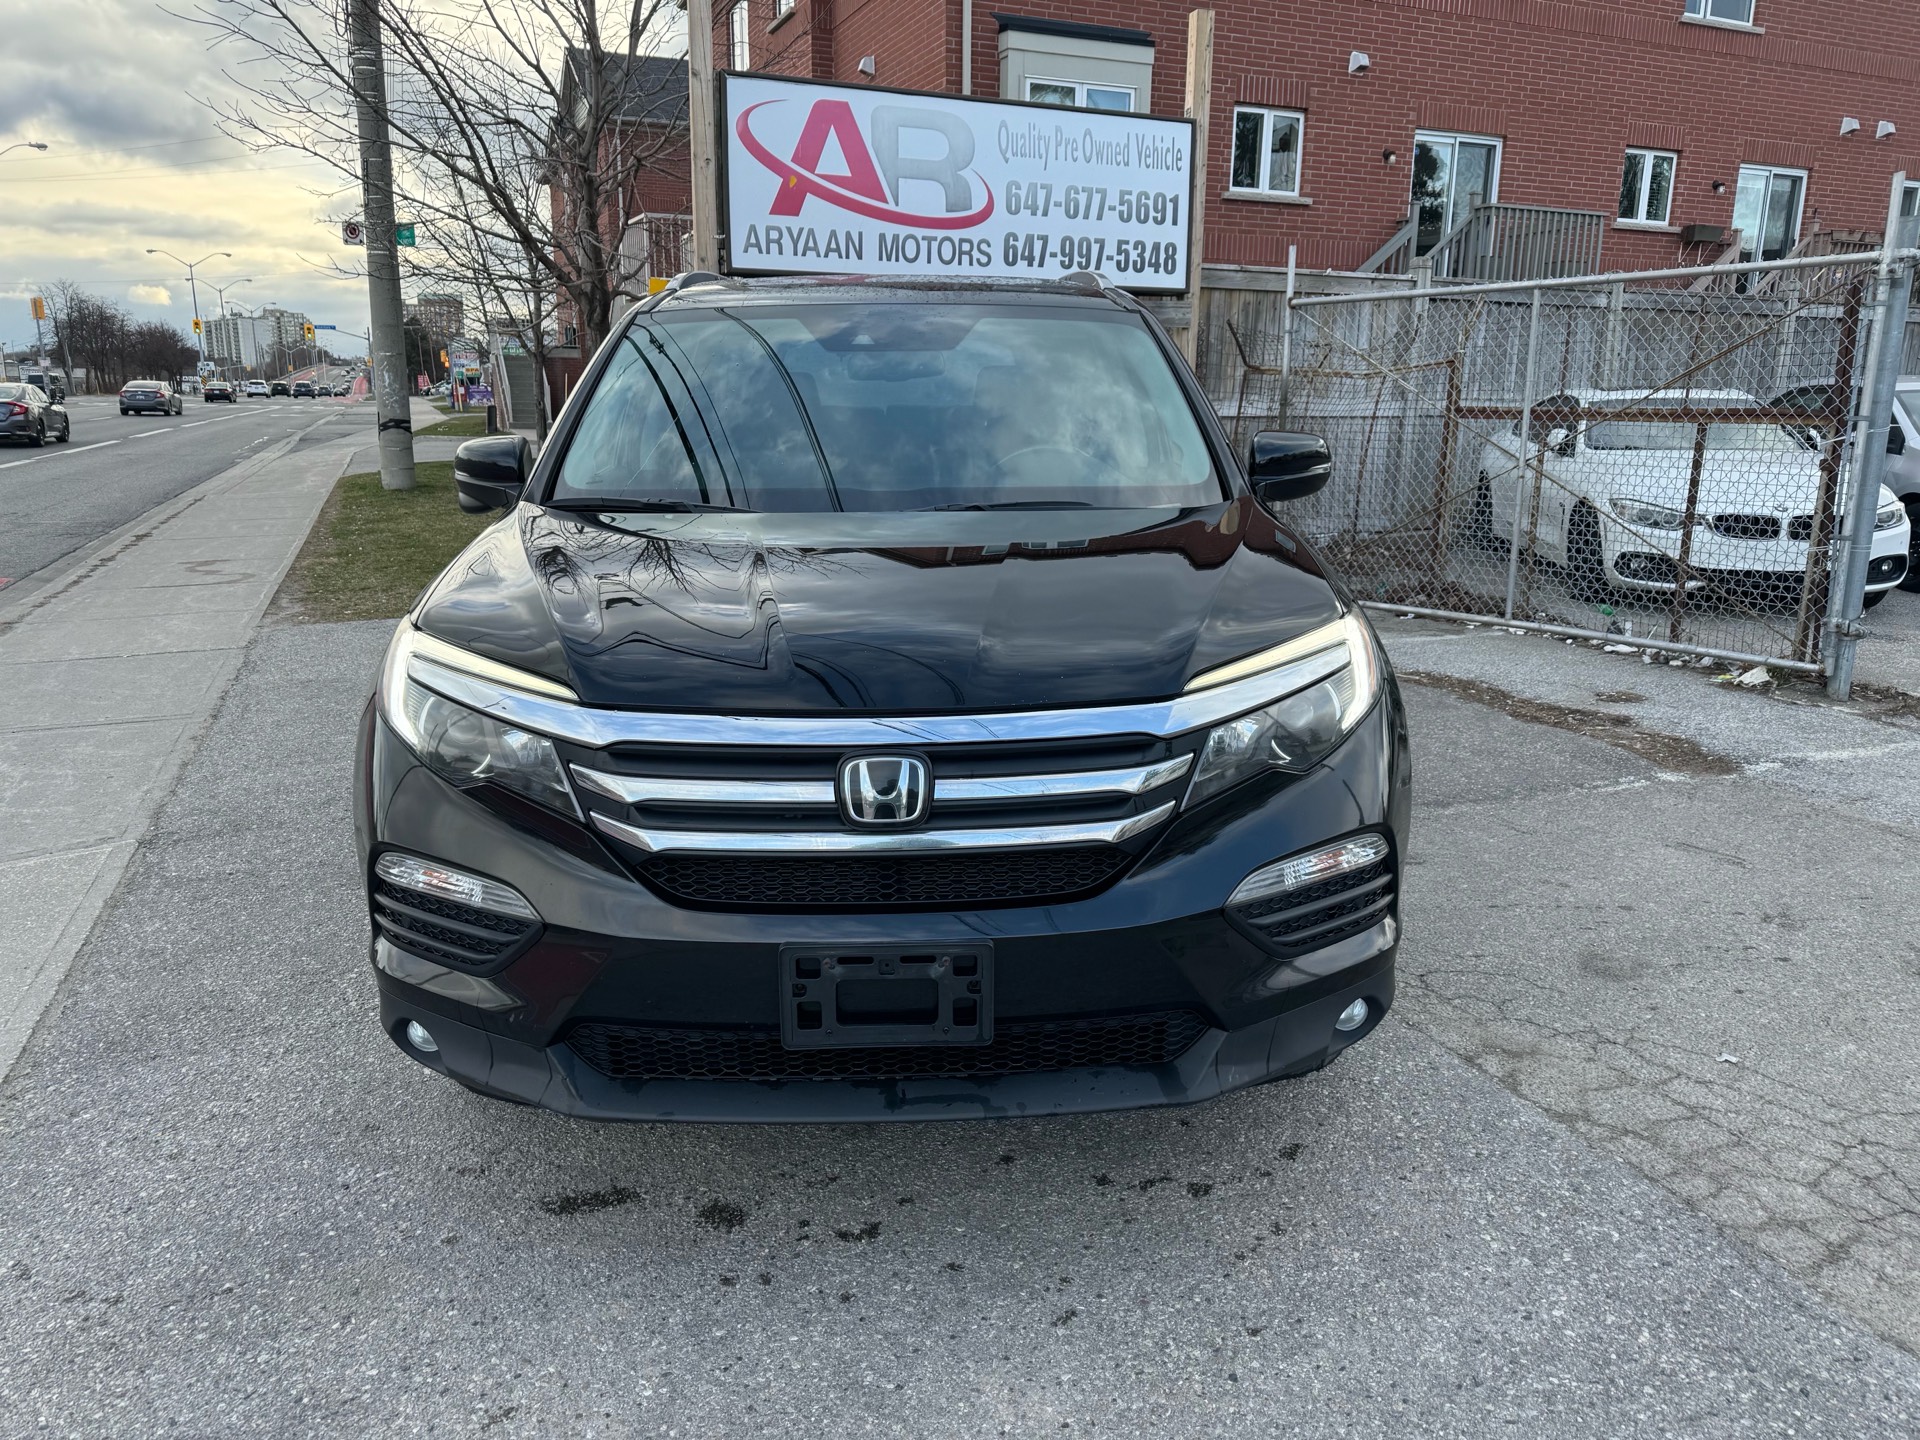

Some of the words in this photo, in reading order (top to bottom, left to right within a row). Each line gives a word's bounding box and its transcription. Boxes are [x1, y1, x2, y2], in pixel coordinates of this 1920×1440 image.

[769, 98, 973, 217] AR
[997, 119, 1051, 171] Quality
[1054, 125, 1079, 163] Pre
[1082, 127, 1130, 168] Owned
[1135, 132, 1183, 172] Vehicle
[1005, 179, 1180, 227] 647-677-5691
[742, 223, 864, 261] ARYAAN
[878, 232, 992, 268] MOTORS
[1003, 231, 1178, 275] 647-997-5348
